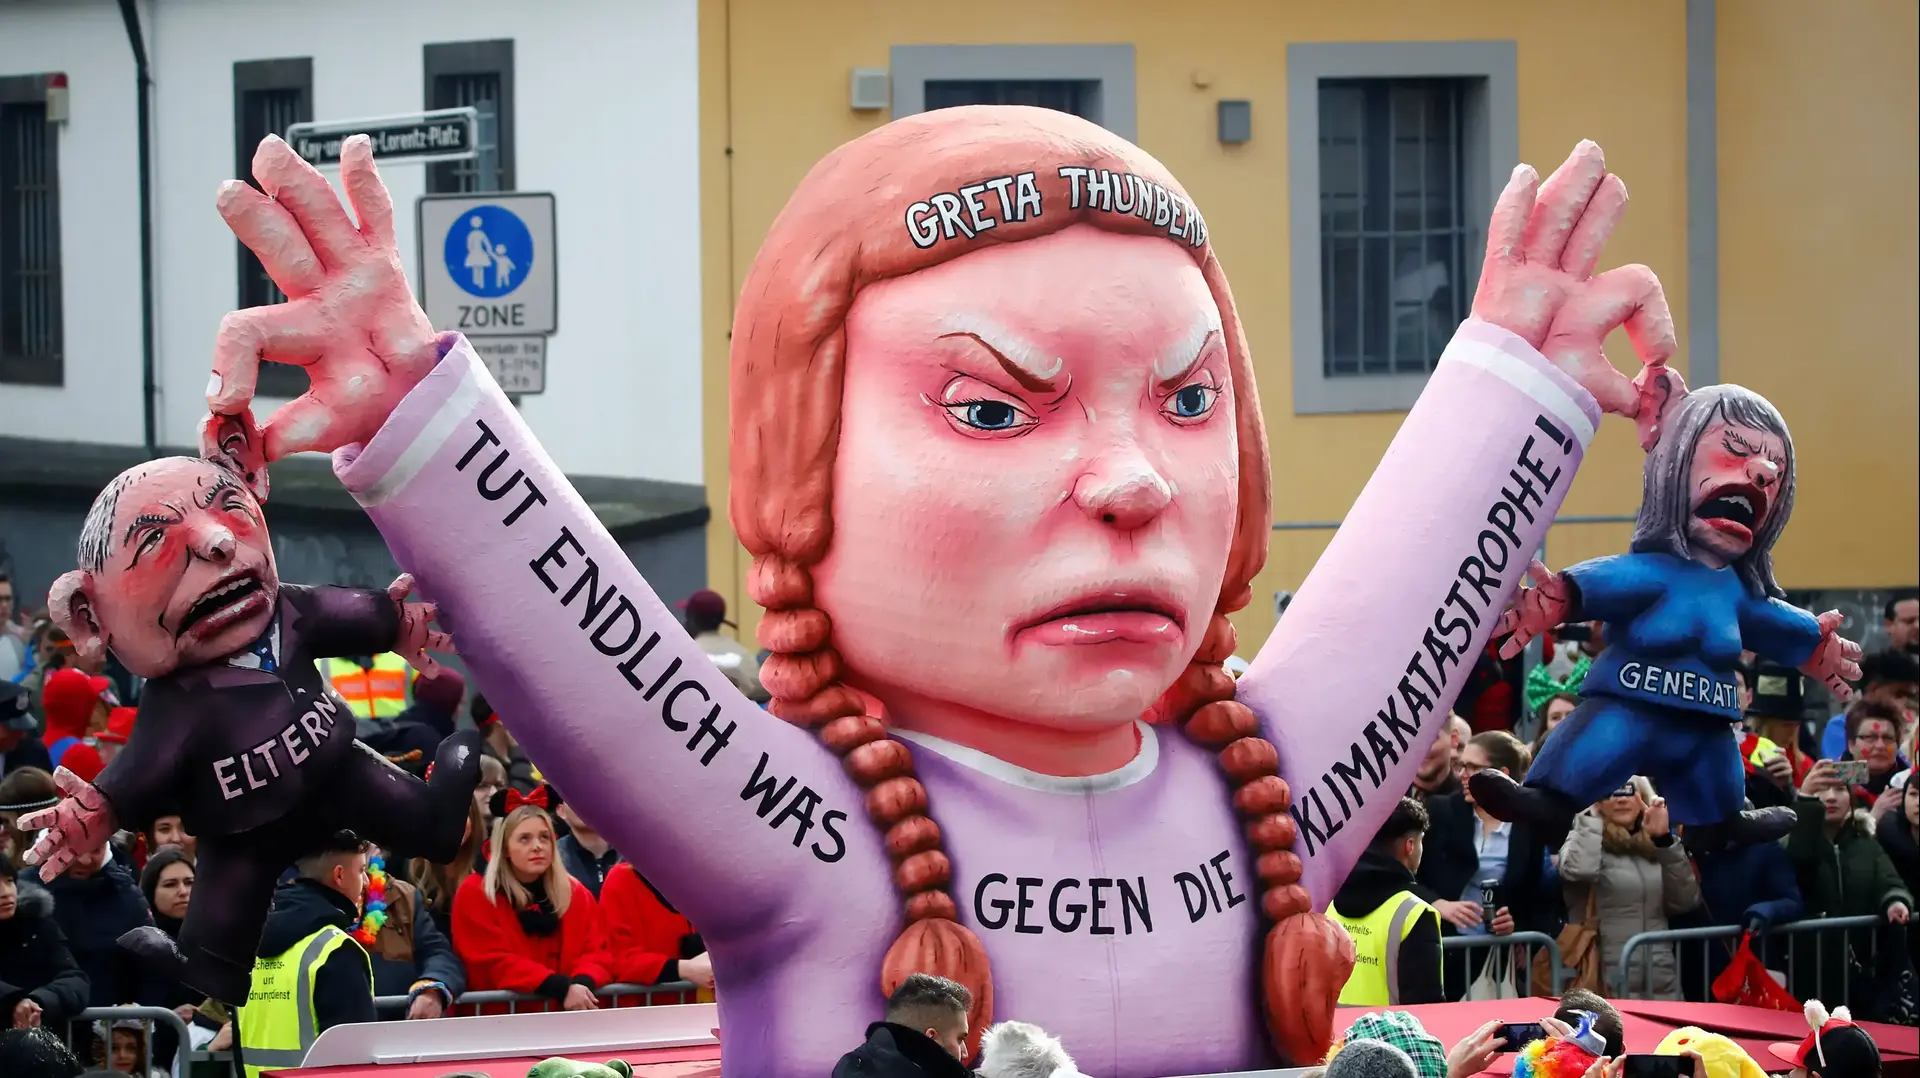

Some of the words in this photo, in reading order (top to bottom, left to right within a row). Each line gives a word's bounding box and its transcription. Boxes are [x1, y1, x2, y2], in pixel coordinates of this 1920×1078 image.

[905, 172, 1042, 249] GRETA
[1058, 166, 1208, 248] THUNBERG
[458, 303, 525, 328] ZONE
[455, 419, 547, 526] TUT
[529, 526, 737, 767] ENDLICH
[740, 752, 847, 863] WAS
[1290, 413, 1574, 857] KLIMAKATASTROPHE!
[212, 692, 337, 800] ELTERN
[974, 873, 1153, 935] GEGEN
[1173, 849, 1246, 923] DIE
